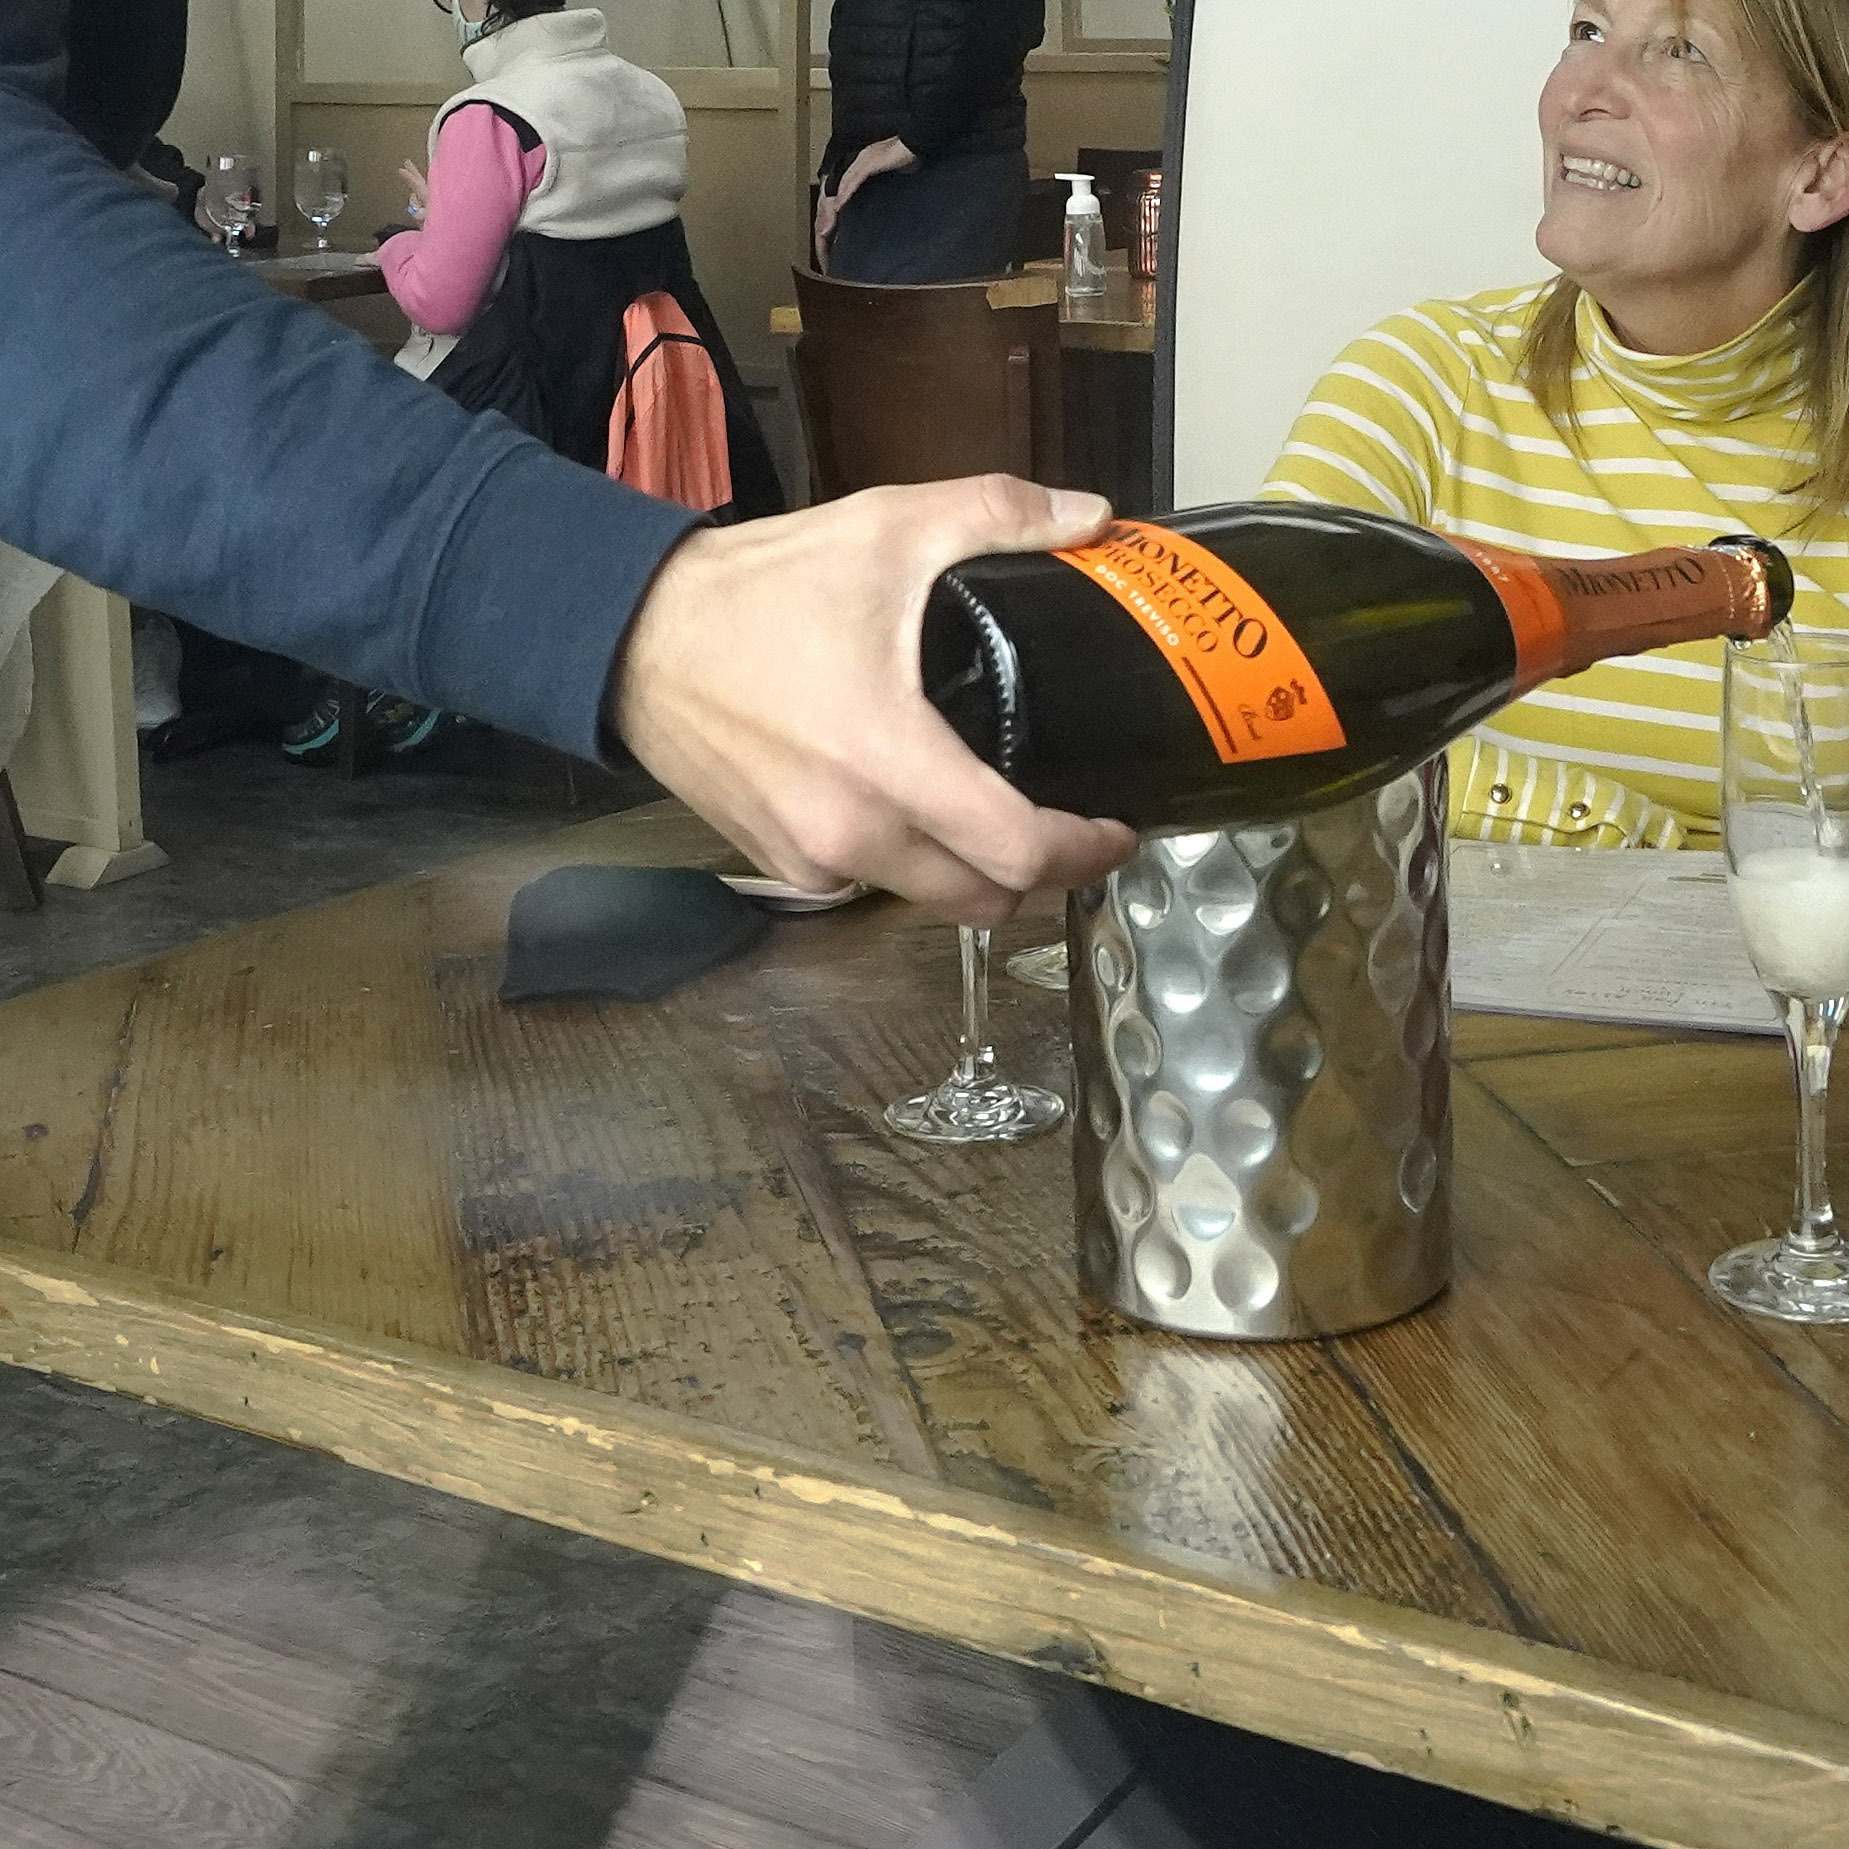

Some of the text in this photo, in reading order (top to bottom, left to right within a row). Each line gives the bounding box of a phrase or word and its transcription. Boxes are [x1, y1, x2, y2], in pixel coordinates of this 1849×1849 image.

[1094, 563, 1180, 647] DOC TREVISO
[1554, 555, 1705, 596] MIONETTO
